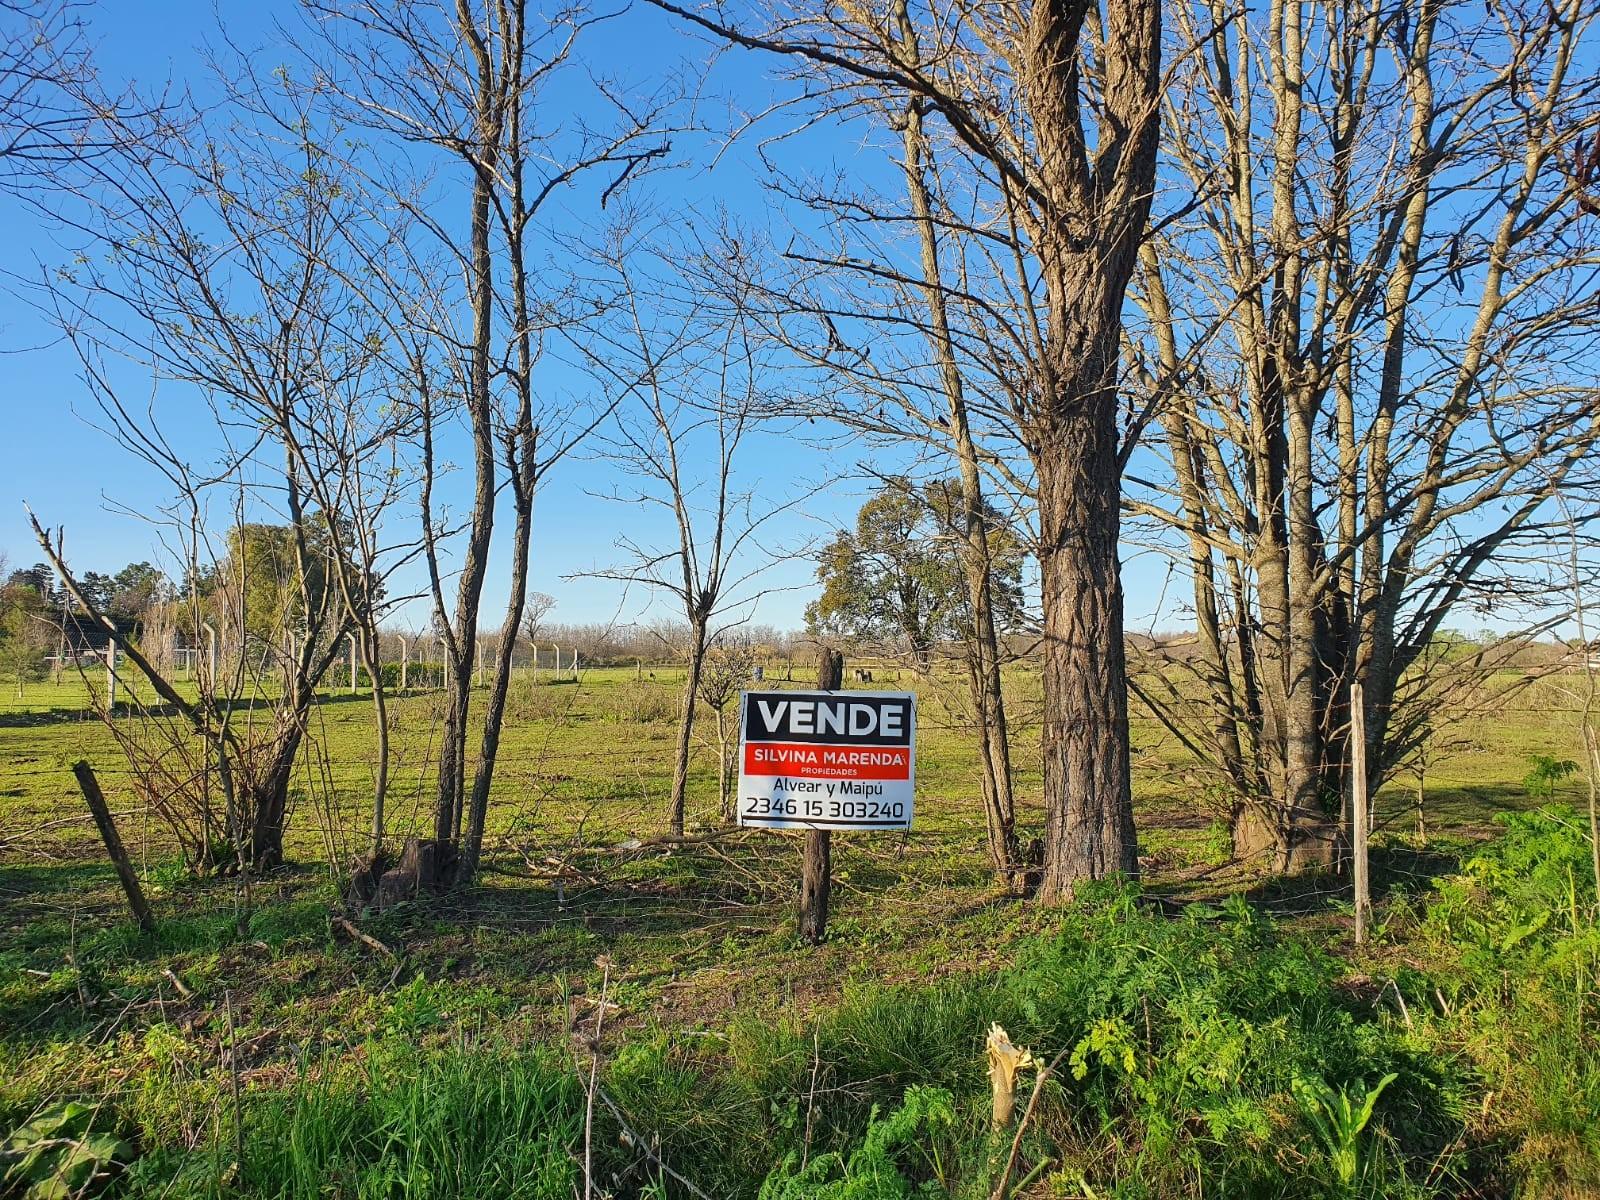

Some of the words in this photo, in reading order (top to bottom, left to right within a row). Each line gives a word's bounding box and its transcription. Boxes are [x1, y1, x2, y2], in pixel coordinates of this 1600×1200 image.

[757, 700, 903, 737] VENDE
[754, 749, 818, 763] SILVINA
[823, 752, 903, 766] MARENDA
[801, 767, 858, 776] PROPIEDADES
[773, 778, 822, 793] Alvear
[826, 784, 836, 798] y
[840, 781, 883, 799] Maipú
[746, 797, 797, 815] 2346
[805, 800, 823, 816] 15
[829, 802, 904, 818] 303240
